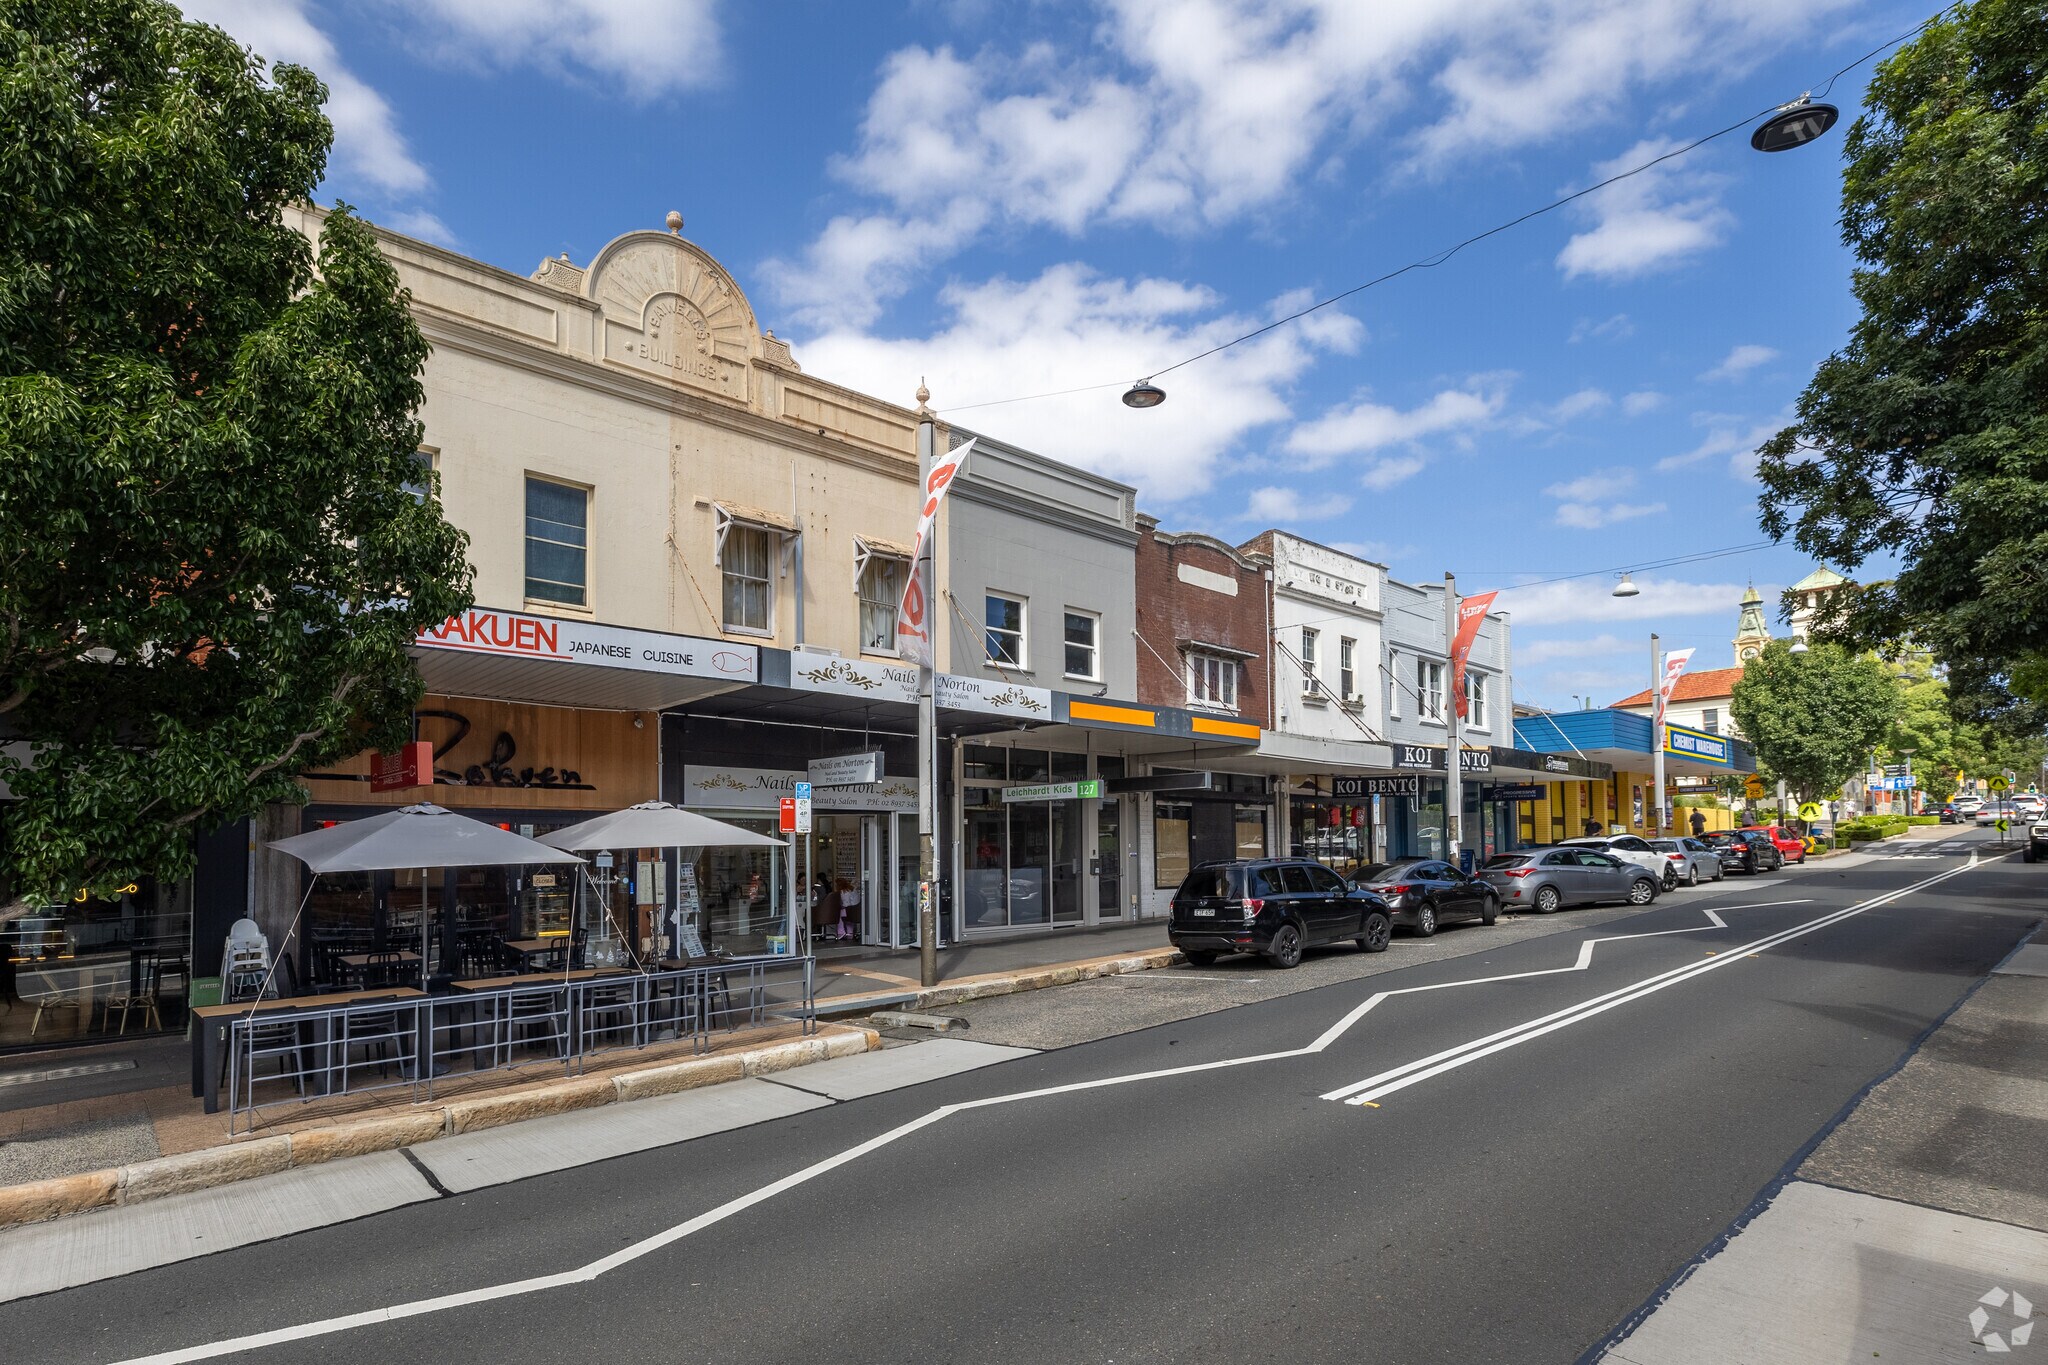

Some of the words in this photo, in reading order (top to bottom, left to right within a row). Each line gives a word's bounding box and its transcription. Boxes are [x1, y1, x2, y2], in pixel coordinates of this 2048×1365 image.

[639, 344, 717, 381] BUILDINGS
[568, 640, 632, 659] JAPANESE
[642, 649, 694, 666] CUISINE
[881, 667, 916, 684] Nails
[937, 676, 981, 694] Norton
[900, 684, 916, 694] Nail
[953, 691, 970, 701] Salon
[947, 700, 961, 708] 3453
[1673, 733, 1695, 751] CHEMIST
[1695, 738, 1724, 757] WAREHOUSE
[1404, 746, 1433, 764] KOI
[818, 760, 833, 770] Nails
[842, 758, 865, 768] Norton
[754, 775, 796, 791] Nails
[1006, 786, 1050, 797] Leichhardt
[1053, 784, 1073, 794] Kids
[1079, 784, 1094, 795] 127
[1336, 780, 1362, 794] KOI
[1368, 778, 1419, 793] BENTO
[811, 797, 837, 806] Beauty
[838, 797, 858, 805] Salon
[866, 798, 879, 806] PH:
[891, 799, 905, 807] 8937
[586, 874, 617, 885] Welcome
